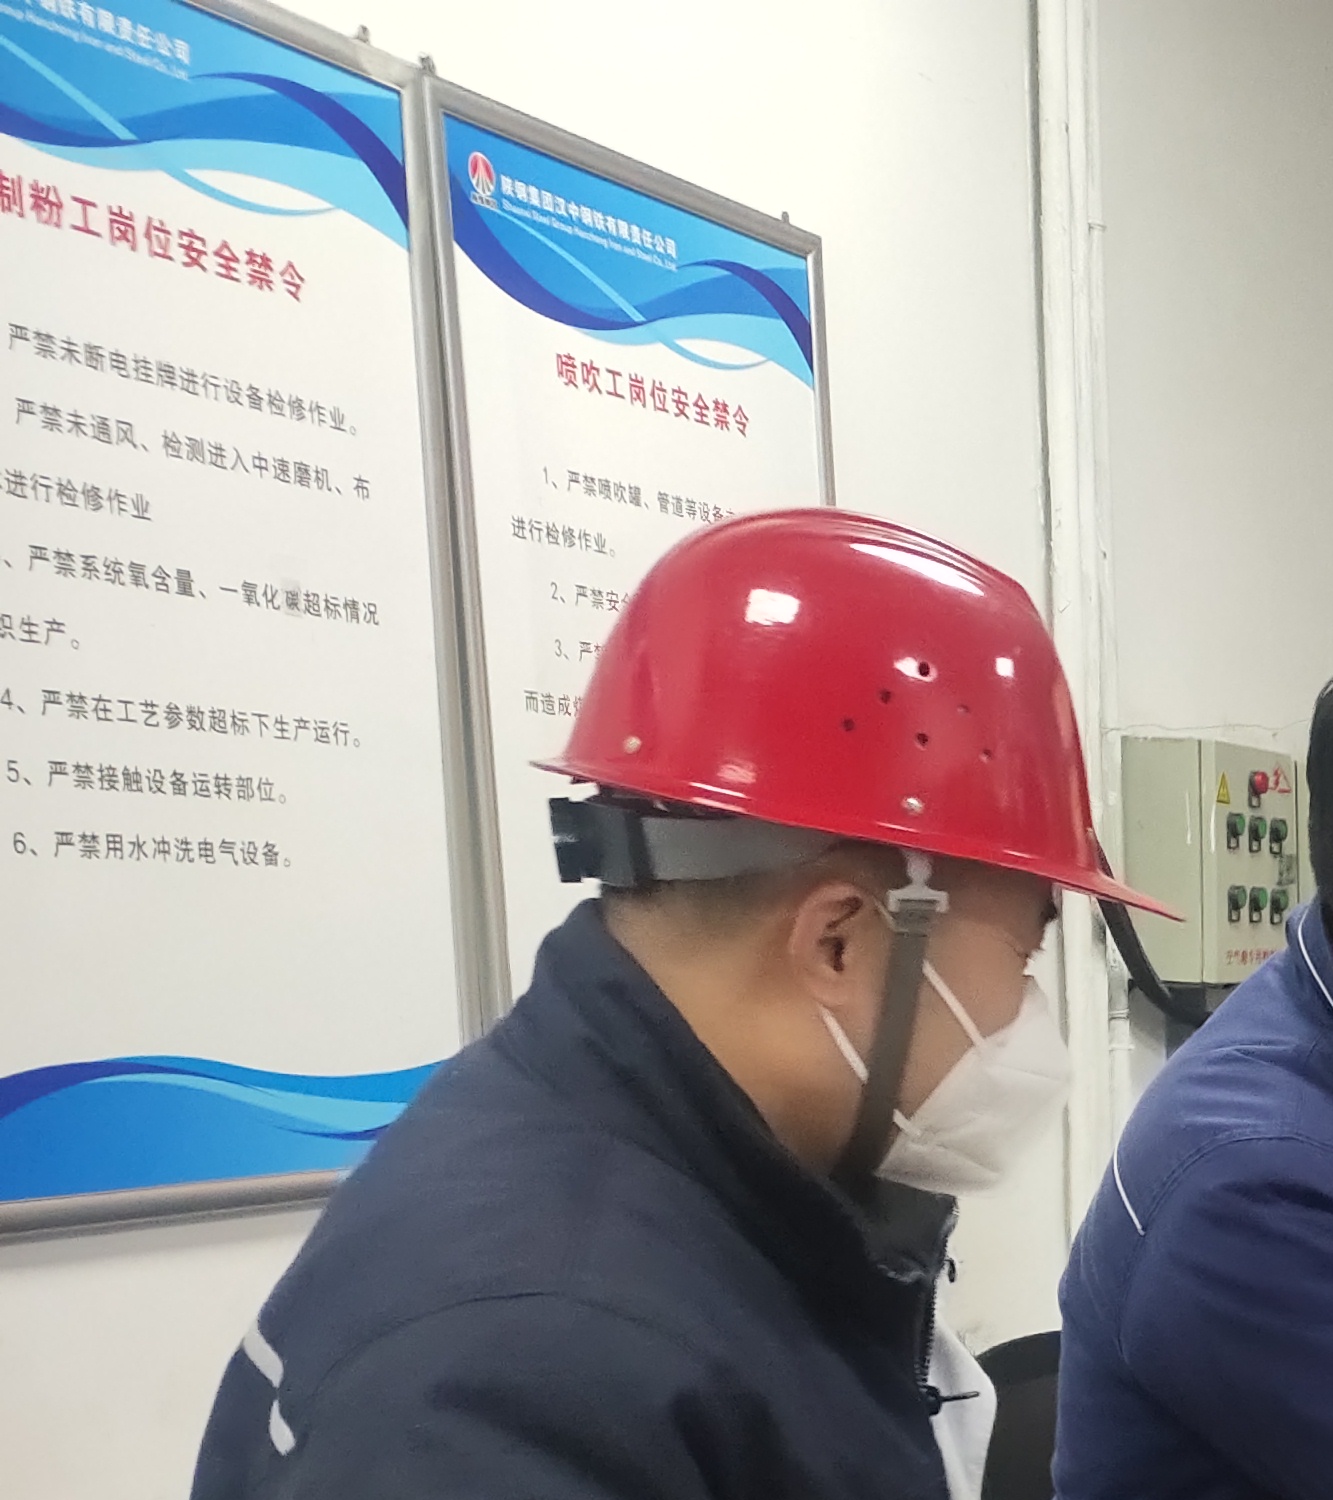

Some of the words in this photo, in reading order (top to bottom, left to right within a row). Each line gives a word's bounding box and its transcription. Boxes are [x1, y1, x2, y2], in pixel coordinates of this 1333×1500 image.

[0, 170, 306, 302] 制粉工岗位安全禁令
[8, 323, 358, 436] 严禁未断电挂牌进行设备检修作业。
[555, 352, 750, 437] 喷吹工岗位安全禁令
[15, 398, 371, 500] 严禁未通风、检测进入中速磨机、布
[0, 468, 152, 522] 进行检修作业
[511, 515, 615, 557] 进行检修作业。
[1, 687, 361, 748] 4、严禁在工艺参数超标下生产运行。
[7, 759, 287, 805] 5、严禁接触设备运转部位。
[13, 832, 291, 868] 6、严禁用水冲洗电气设备。
